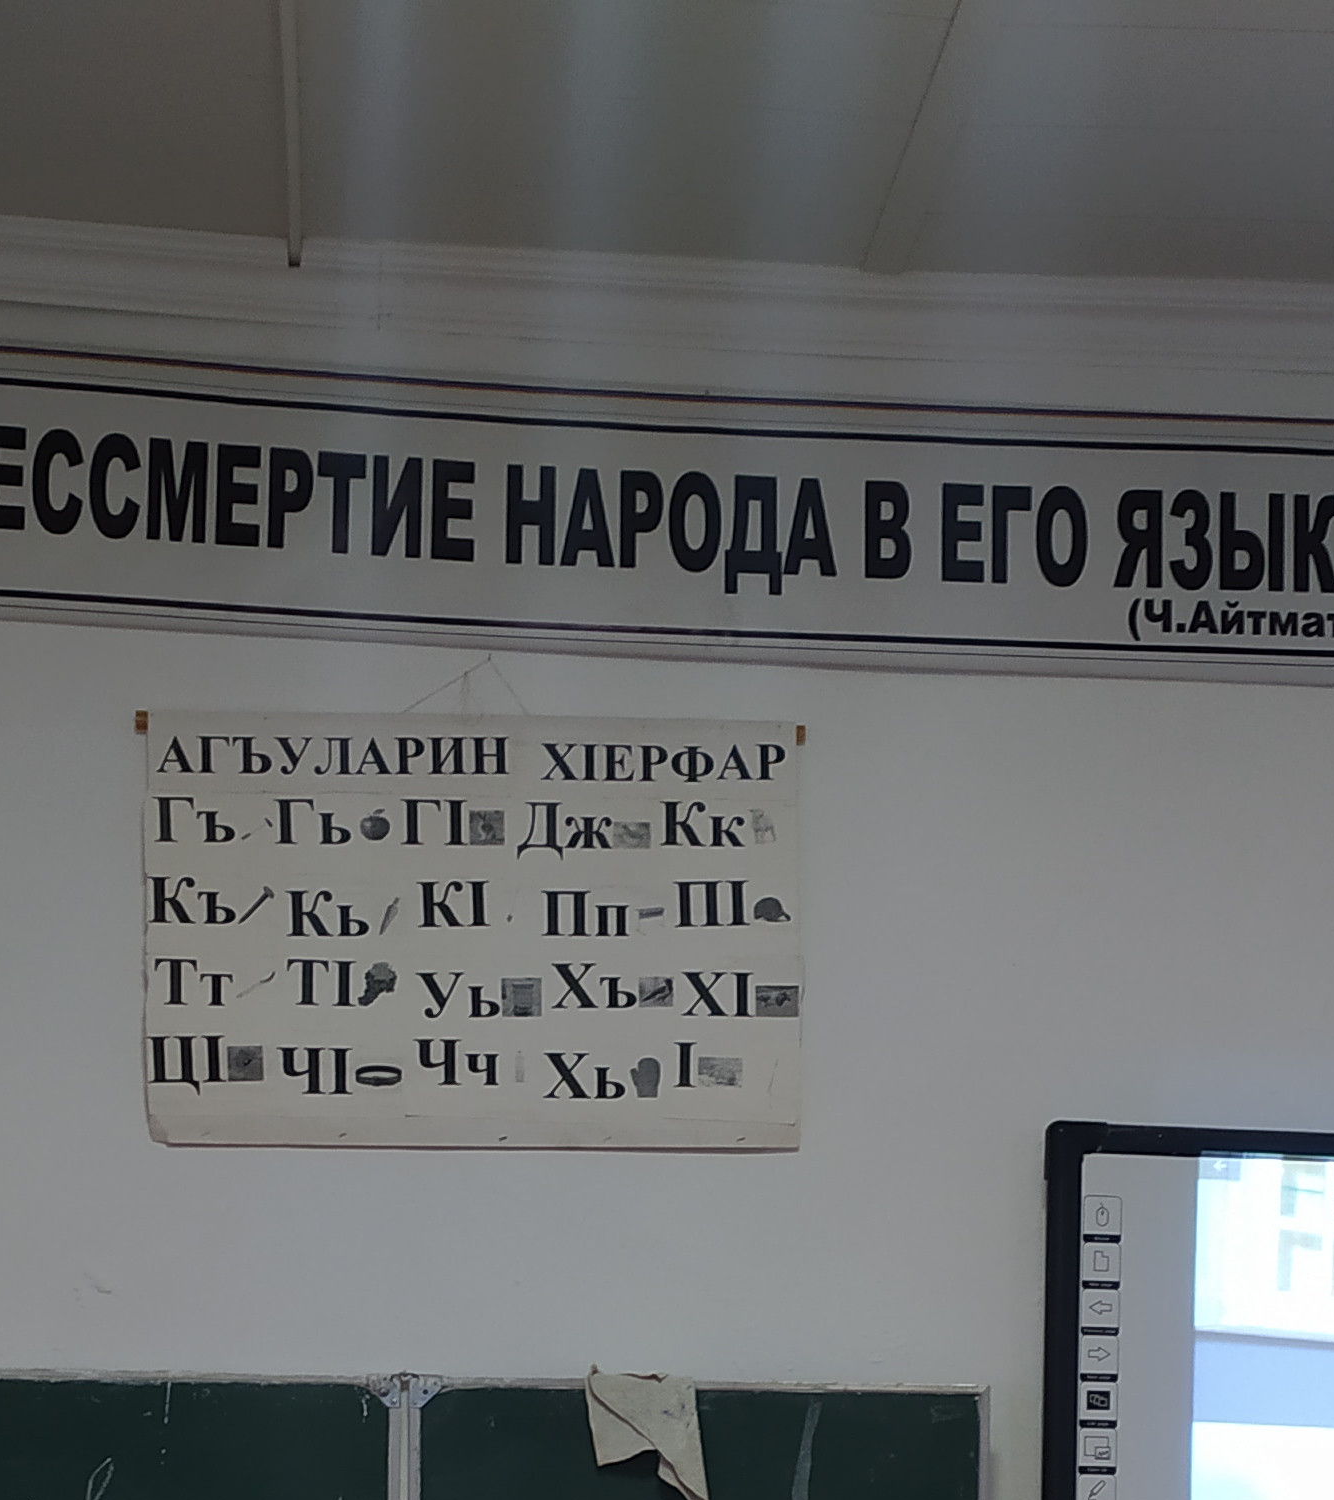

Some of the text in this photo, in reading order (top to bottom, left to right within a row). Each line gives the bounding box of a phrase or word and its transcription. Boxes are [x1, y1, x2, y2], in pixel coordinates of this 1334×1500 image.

[506, 464, 837, 595] НАРОДА
[865, 481, 911, 579] В
[942, 483, 1087, 587] ЕГО
[157, 736, 509, 775] АГЪУЛАРИН
